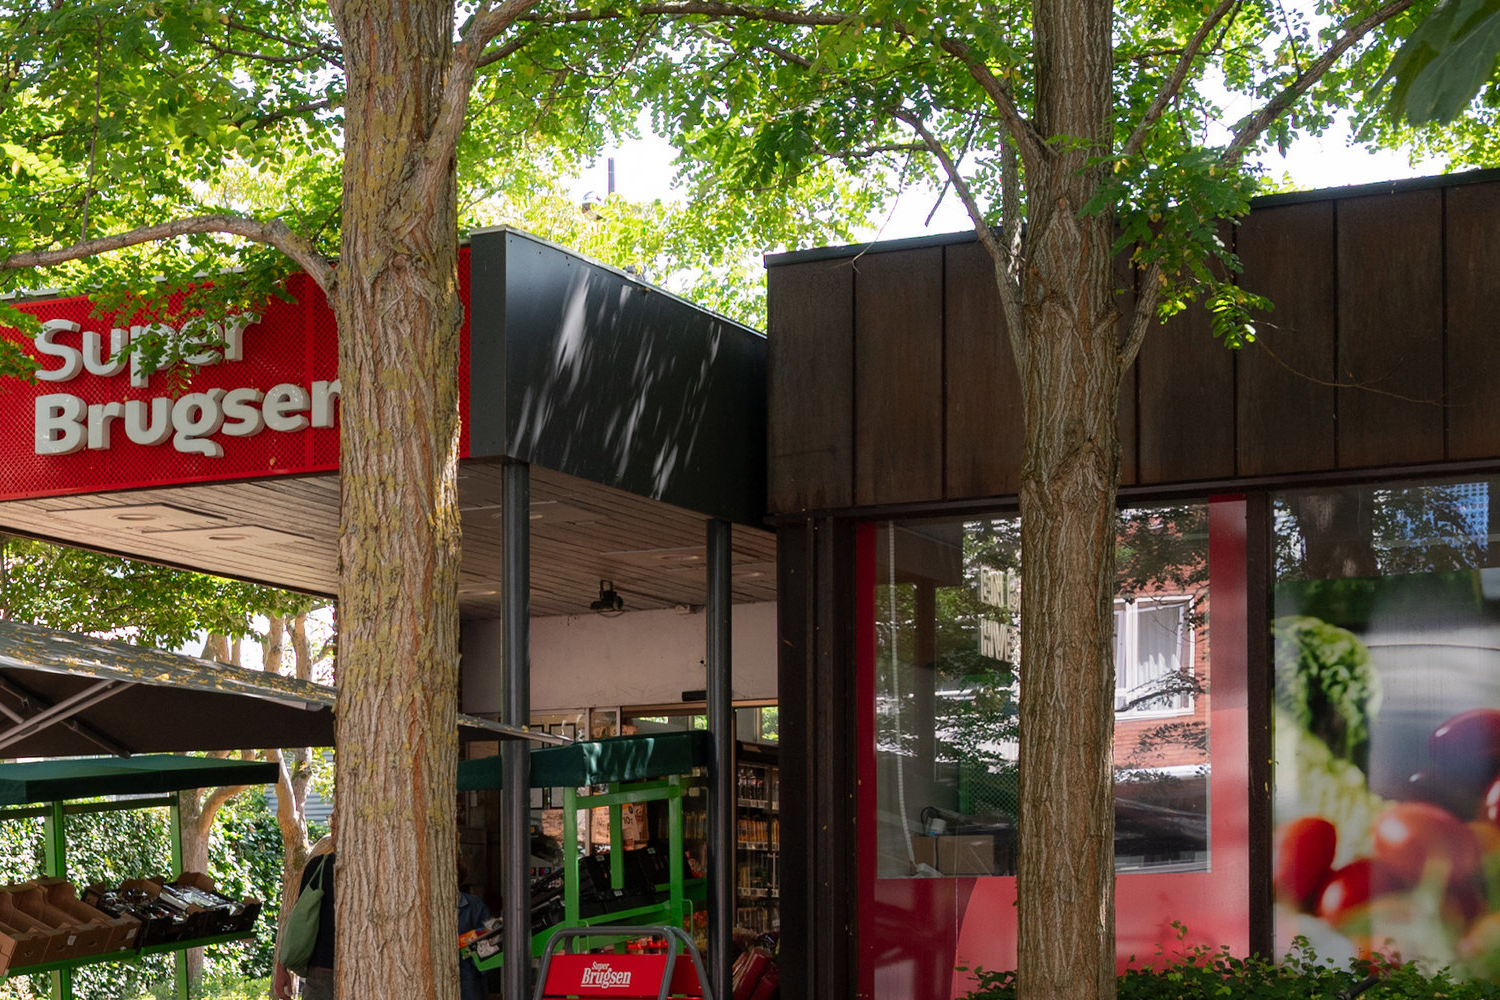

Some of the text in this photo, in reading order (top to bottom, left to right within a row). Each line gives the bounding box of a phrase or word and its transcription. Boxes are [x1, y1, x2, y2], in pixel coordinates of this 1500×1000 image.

[34, 312, 262, 389] Super
[591, 961, 610, 972] Super
[581, 967, 631, 989] Brugsen
